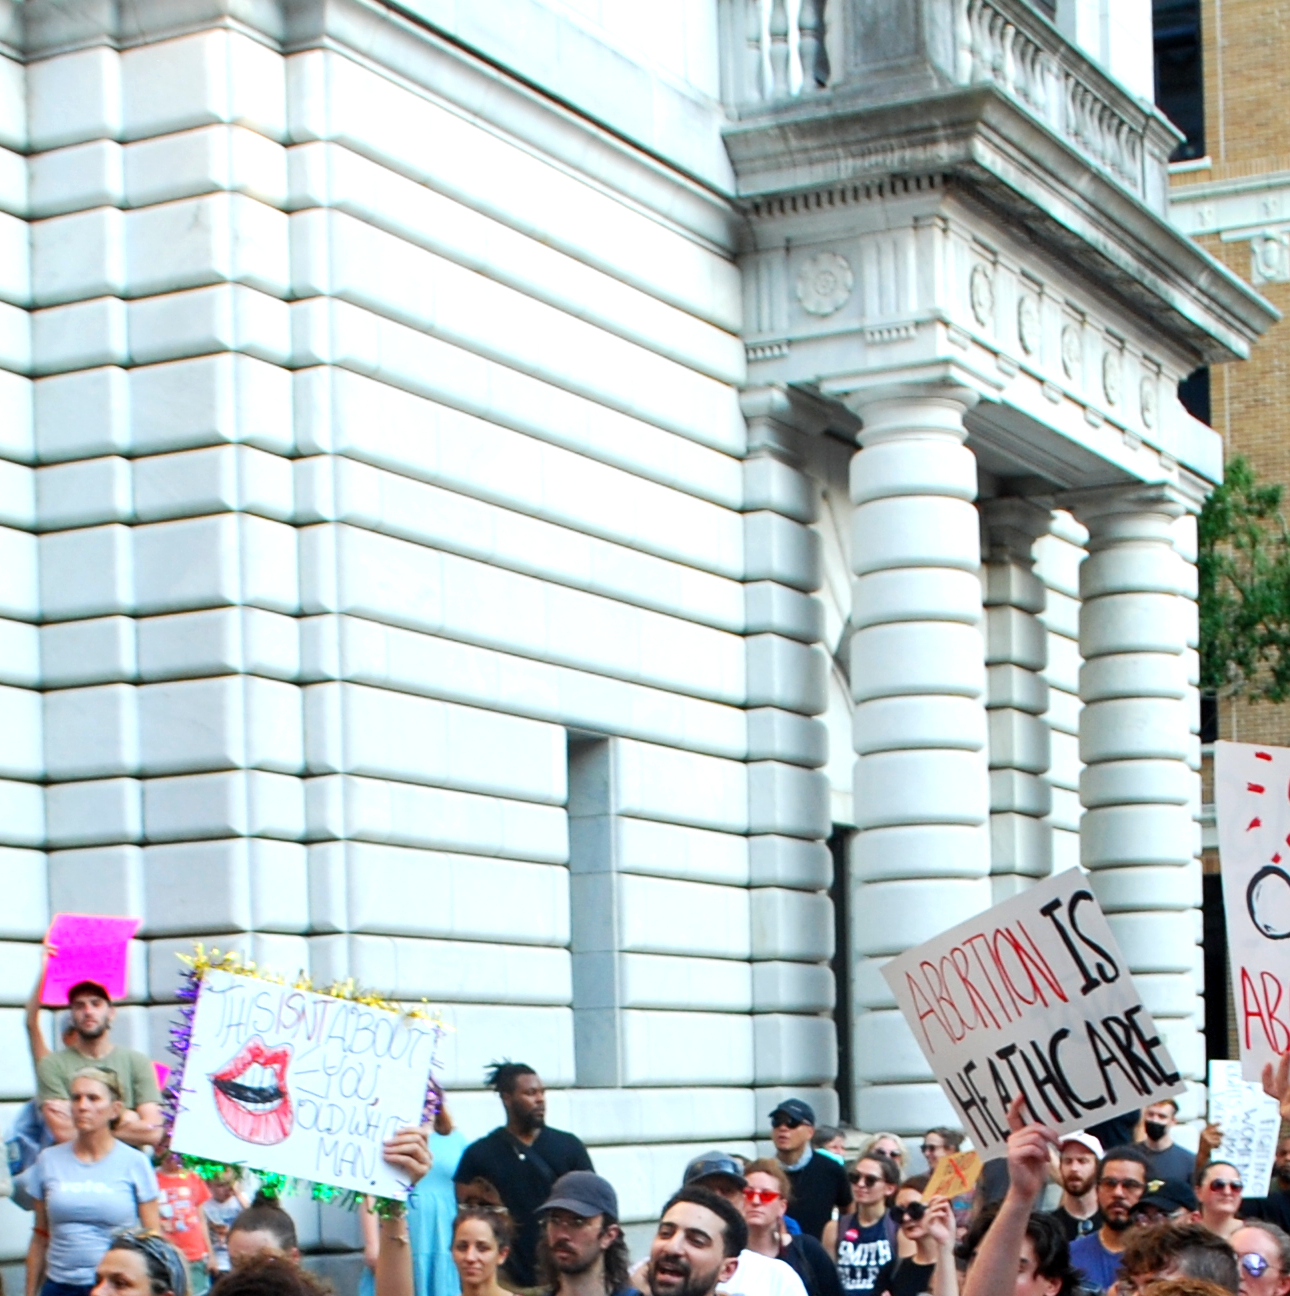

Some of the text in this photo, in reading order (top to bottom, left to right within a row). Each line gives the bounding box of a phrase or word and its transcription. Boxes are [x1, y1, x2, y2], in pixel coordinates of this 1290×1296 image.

[905, 889, 1121, 1054] ABORTION IS
[206, 985, 276, 1048] THIS
[325, 1003, 429, 1067] ABOUT
[295, 1098, 410, 1143] OLD WHIT
[837, 1239, 893, 1267] SMITH
